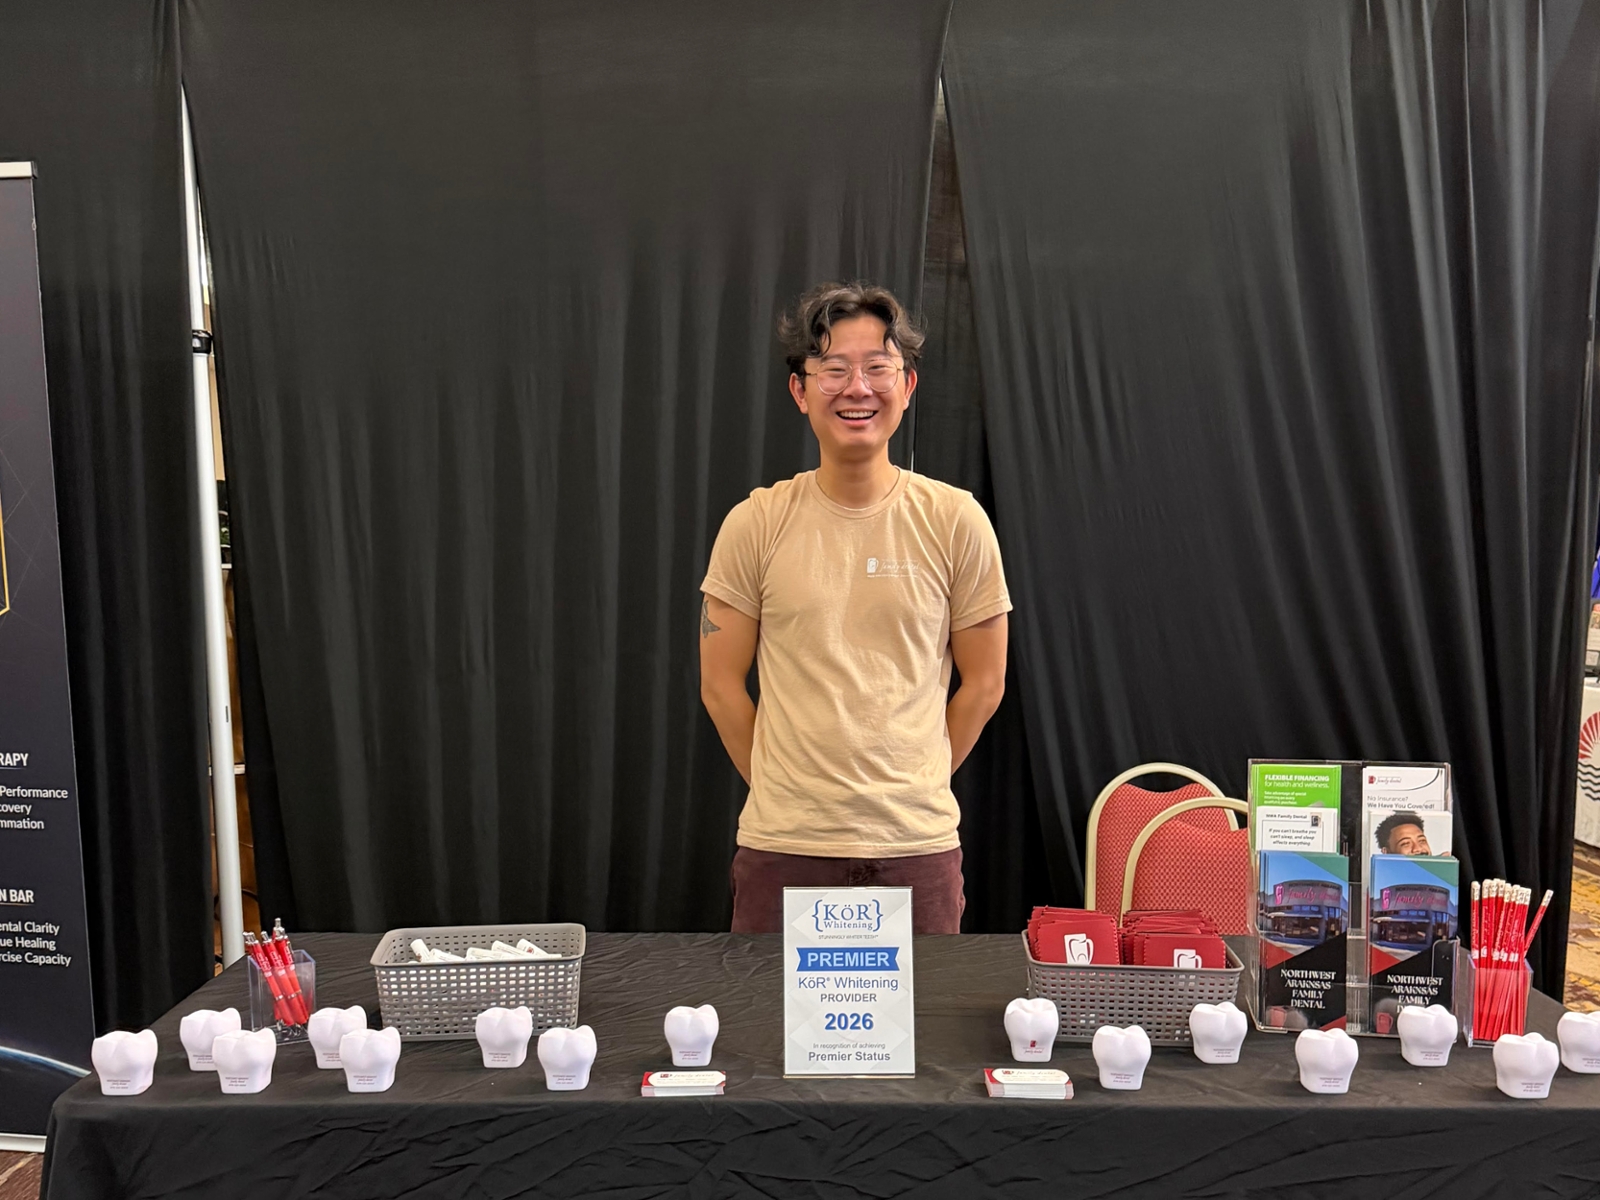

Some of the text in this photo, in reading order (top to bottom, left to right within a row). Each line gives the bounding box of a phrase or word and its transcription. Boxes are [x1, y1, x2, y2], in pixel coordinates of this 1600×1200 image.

[0, 785, 69, 799] Performance
[0, 803, 32, 815] overy
[9, 889, 34, 903] BAR
[0, 920, 60, 936] ntal Clarity
[824, 920, 873, 931] Whitening
[15, 936, 56, 951] Healing
[24, 952, 72, 967] Capacity
[807, 953, 890, 967] PREMIER
[1281, 969, 1336, 980] NORTHWEST
[1387, 974, 1443, 986] NORTHWEST
[834, 977, 899, 991] Whitening
[820, 993, 877, 1002] PROVIDER
[1292, 989, 1324, 999] FAMILY
[1399, 995, 1430, 1005] FAMILY
[1291, 999, 1325, 1009] DENTAL
[825, 1012, 874, 1030] 2026
[809, 1052, 890, 1061] Premier Status
